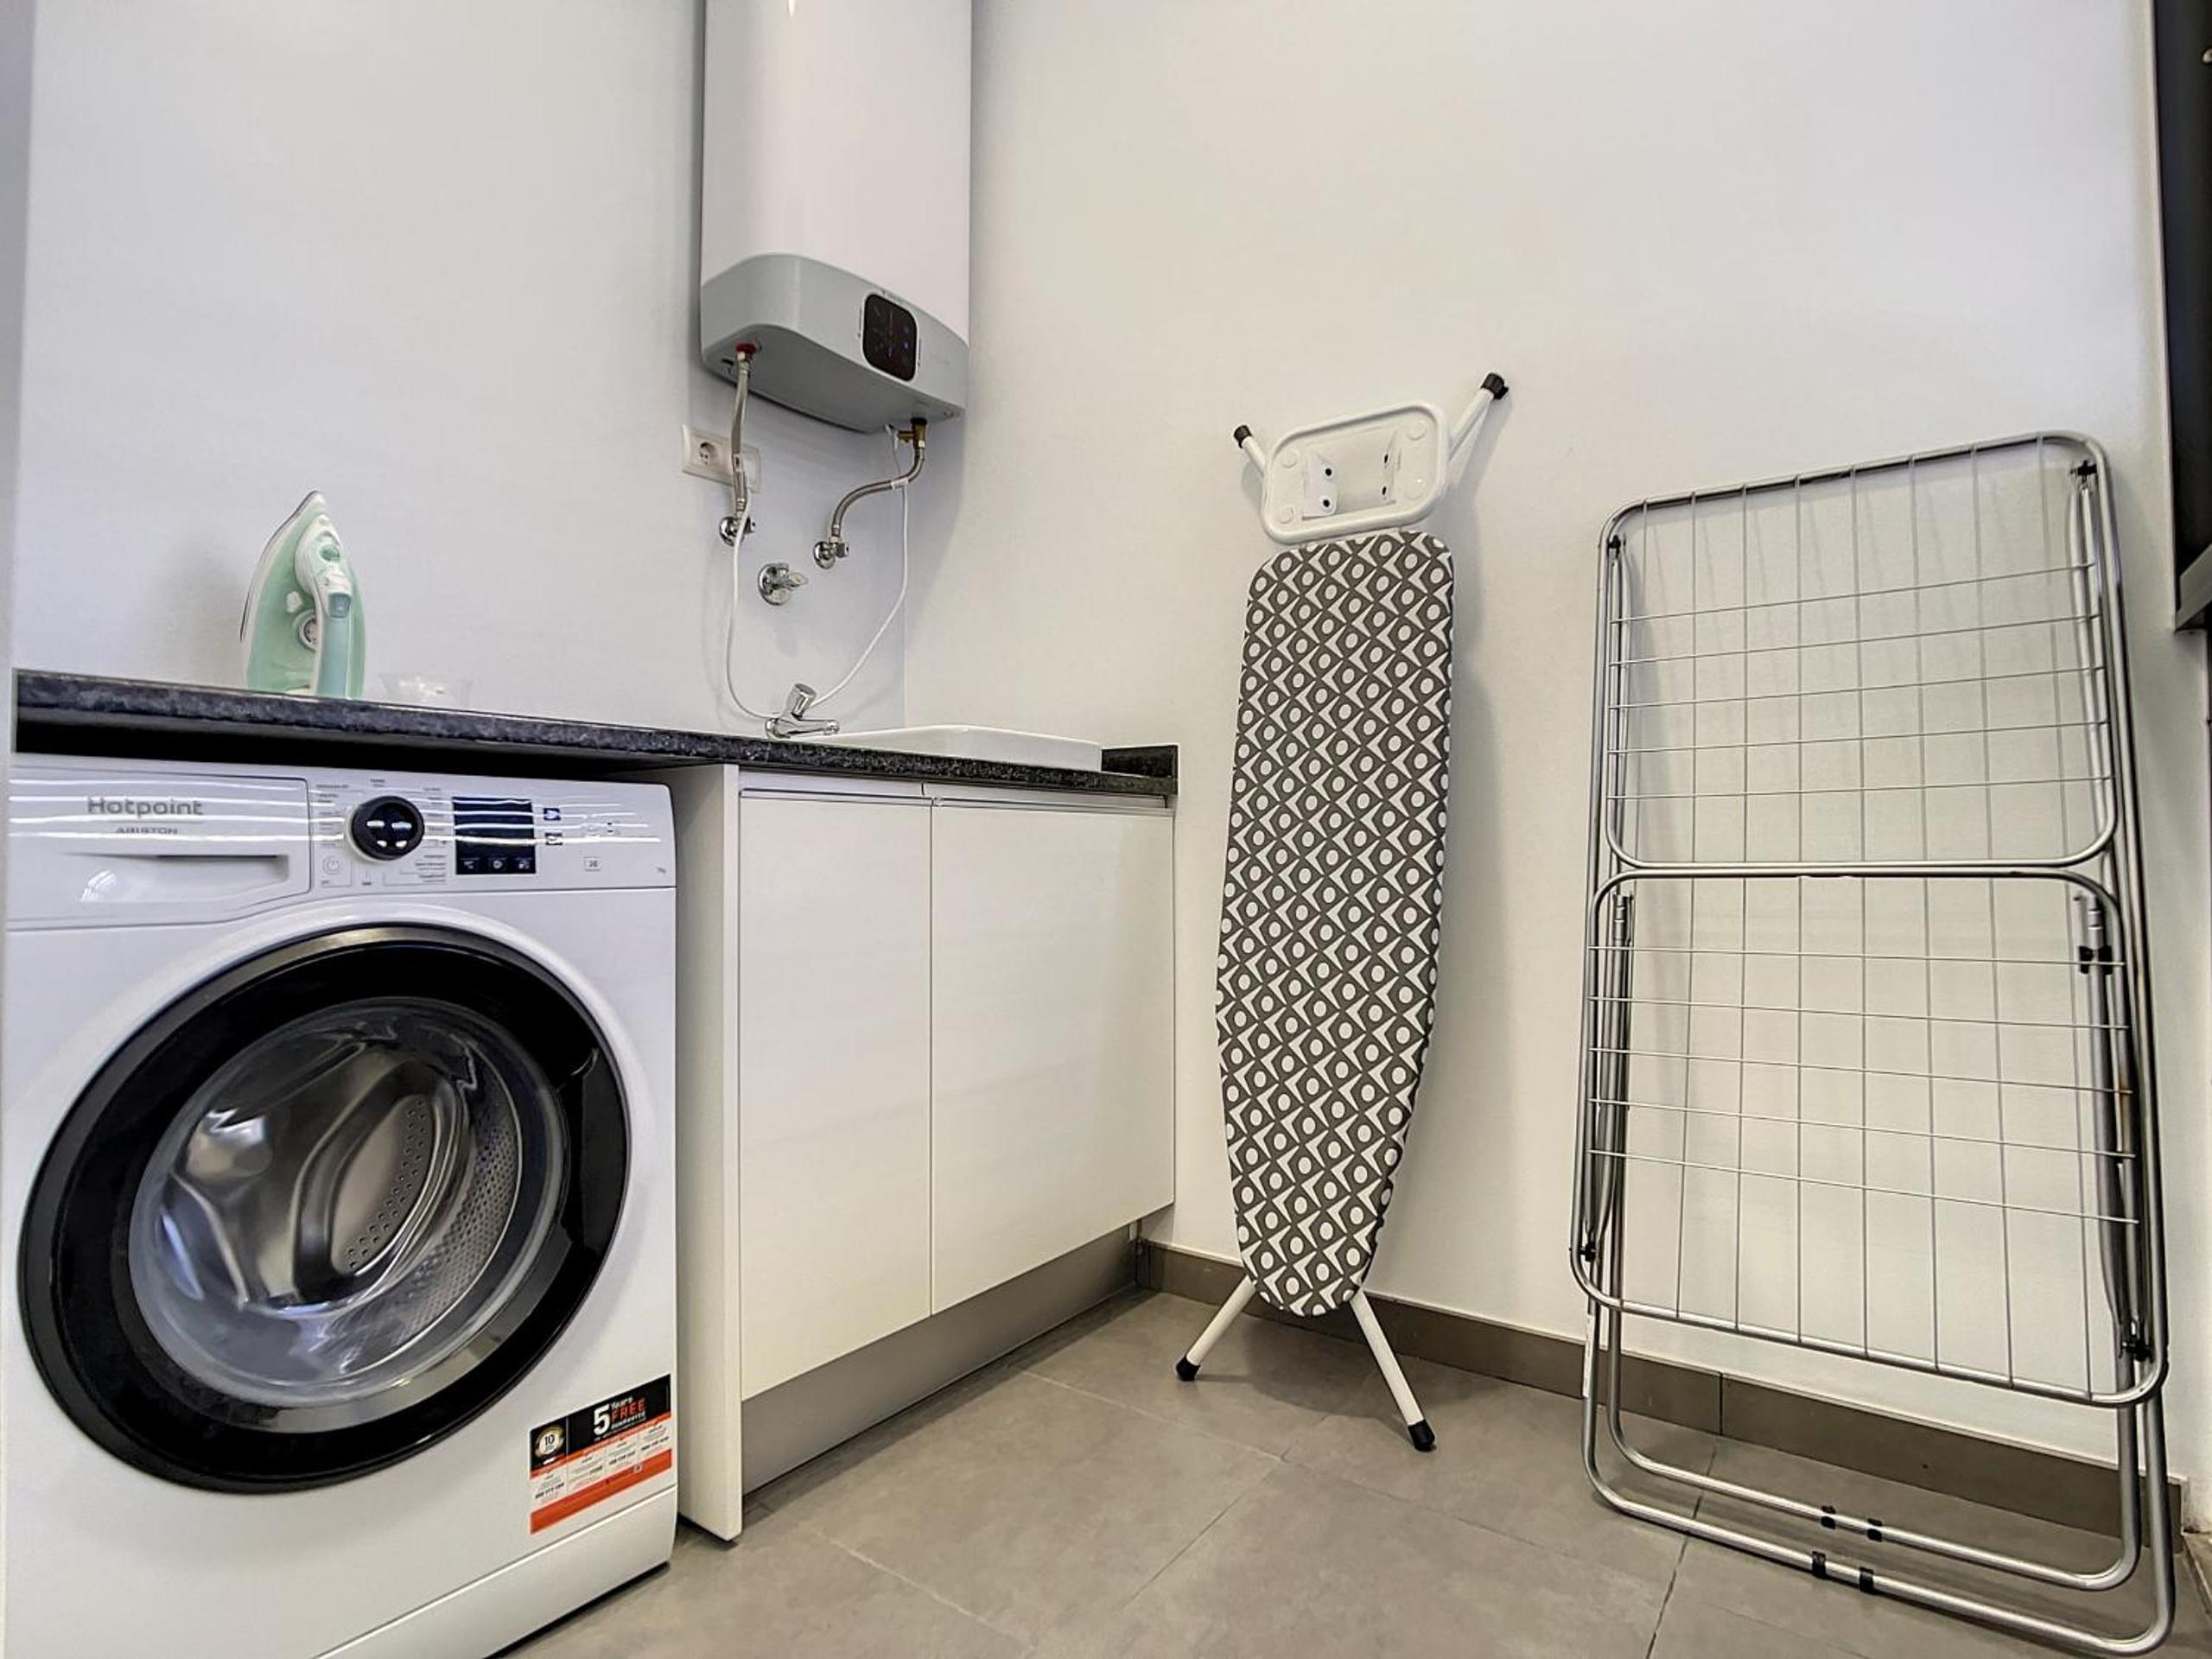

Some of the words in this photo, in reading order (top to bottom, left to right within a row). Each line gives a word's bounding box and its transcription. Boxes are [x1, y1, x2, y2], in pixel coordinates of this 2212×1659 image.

[88, 797, 203, 818] Hotpoint
[594, 1404, 610, 1436] 5
[611, 1399, 646, 1422] FREE
[544, 1434, 555, 1446] 10
